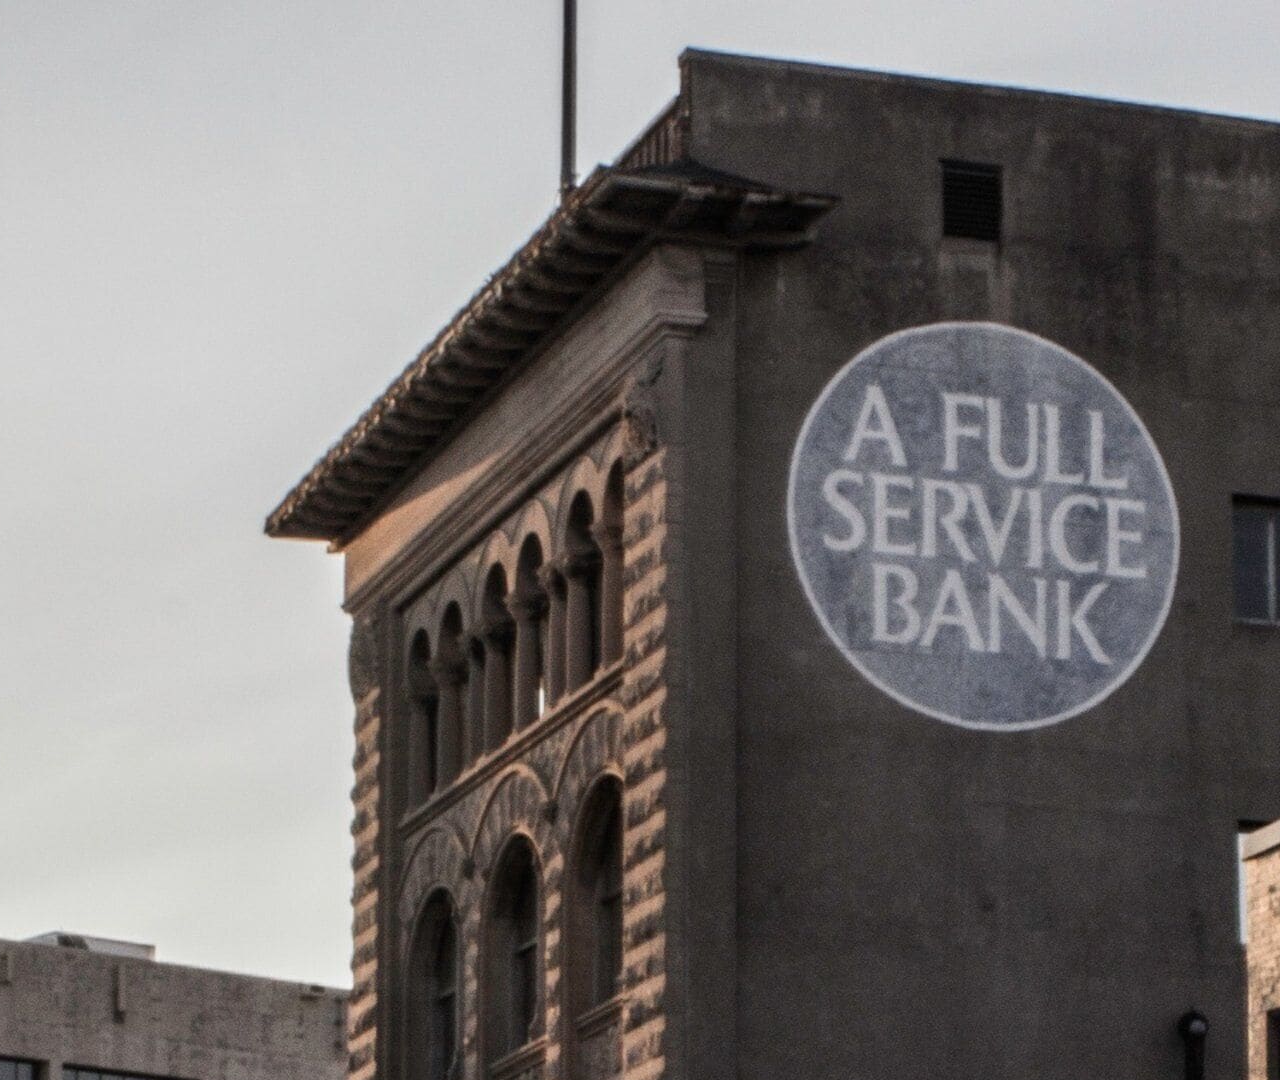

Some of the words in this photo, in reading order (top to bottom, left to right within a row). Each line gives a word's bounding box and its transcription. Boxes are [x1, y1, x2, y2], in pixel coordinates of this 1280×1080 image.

[841, 384, 908, 467] A
[941, 392, 1129, 490] FULL
[822, 468, 1148, 579] SERVICE
[871, 561, 1113, 665] BANK
